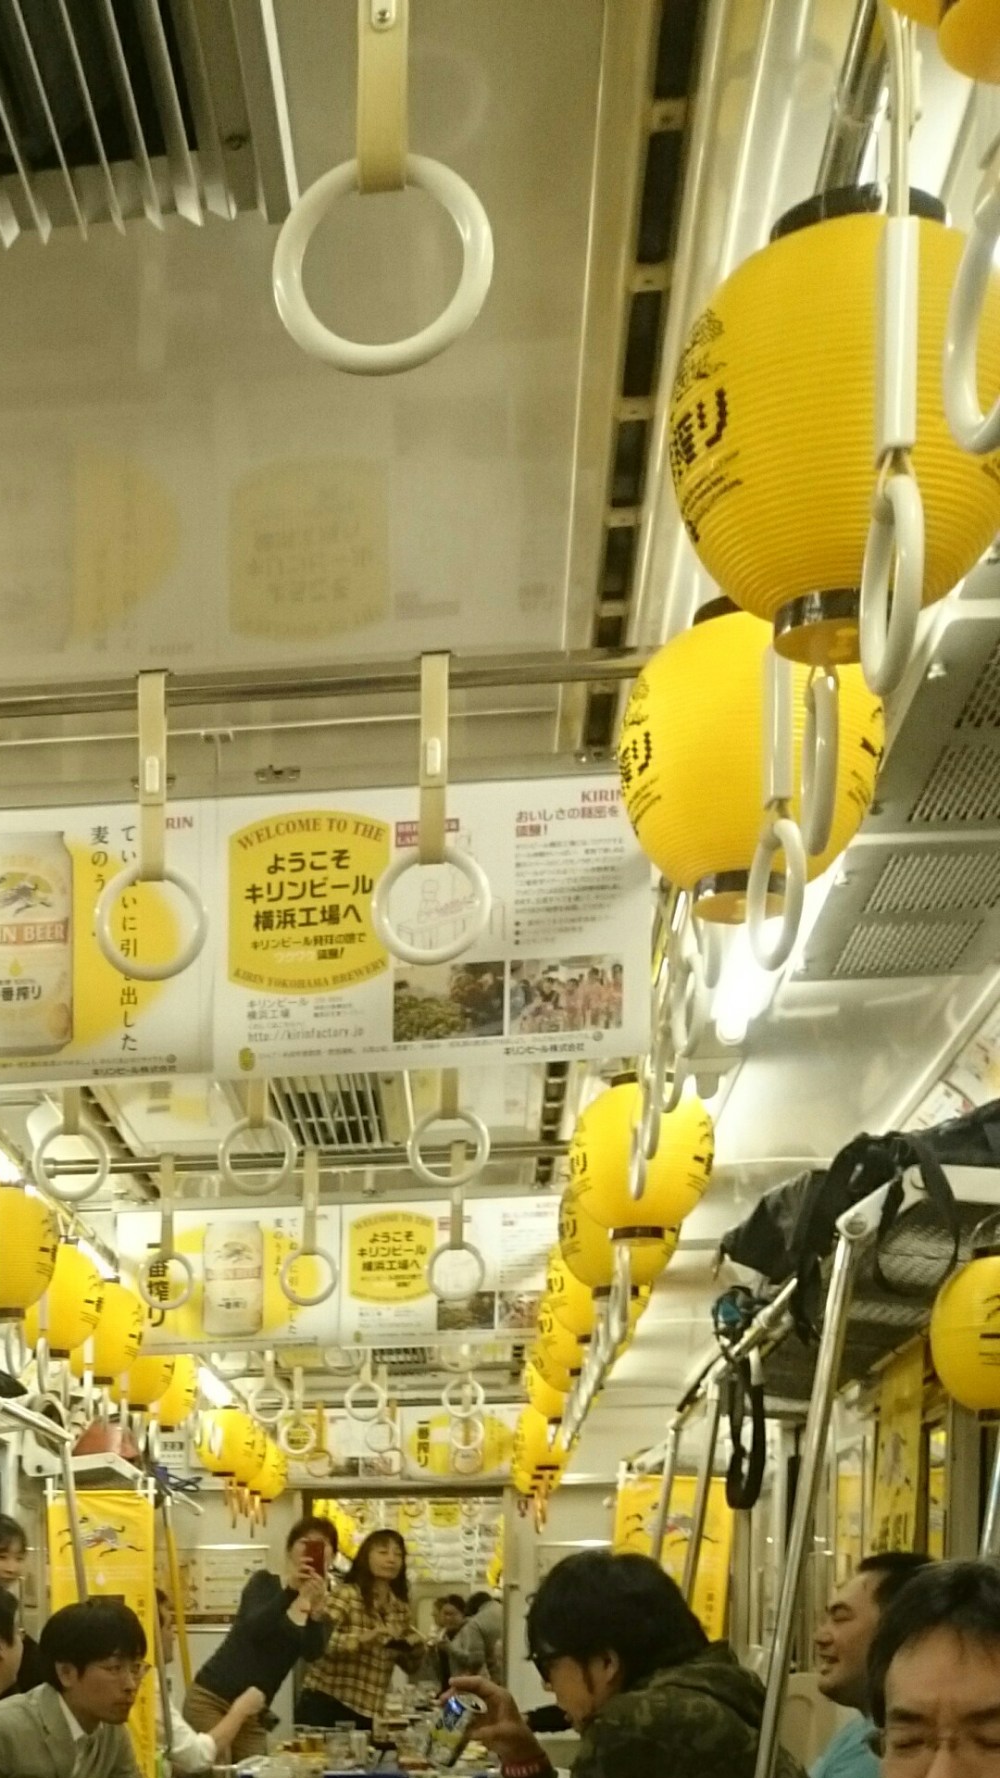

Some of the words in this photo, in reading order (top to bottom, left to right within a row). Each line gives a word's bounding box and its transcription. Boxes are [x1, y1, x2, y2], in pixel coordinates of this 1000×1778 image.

[165, 816, 194, 829] RIN
[237, 818, 321, 850] WELCOME
[326, 818, 347, 833] TO
[350, 821, 386, 843] THE
[267, 849, 351, 875] ようこそ
[244, 874, 374, 904] キリンビール
[254, 904, 363, 932] 横浜工場へ
[23, 922, 66, 943] BEER
[369, 1230, 415, 1244] ようこそ
[357, 1244, 428, 1258] キリンビール
[361, 1259, 421, 1272] 横浜工場へ
